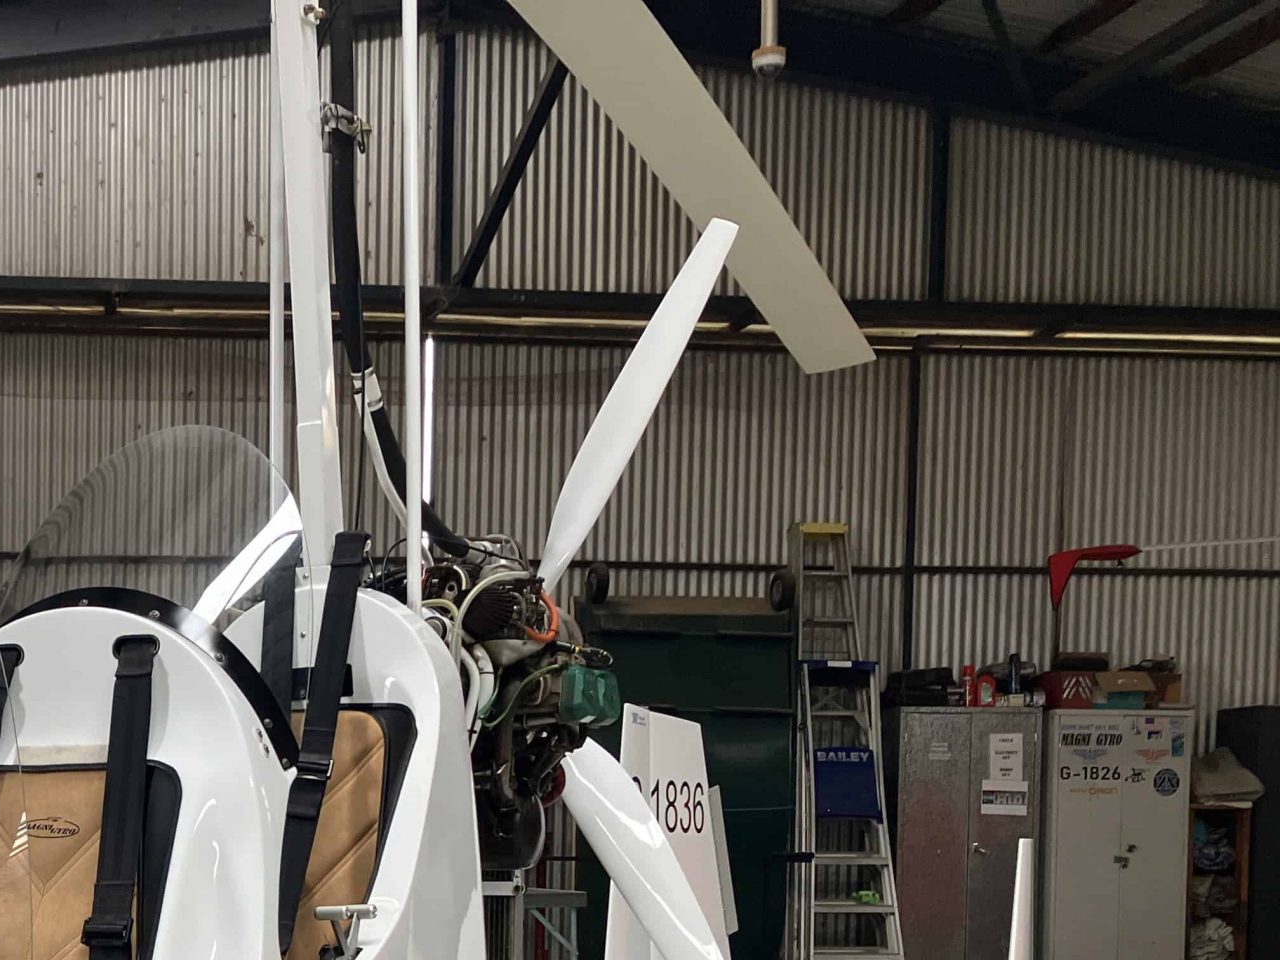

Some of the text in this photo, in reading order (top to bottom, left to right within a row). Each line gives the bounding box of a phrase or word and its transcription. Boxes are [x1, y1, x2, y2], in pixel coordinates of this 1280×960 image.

[1061, 733, 1123, 746] MAGNI GYRO
[817, 751, 869, 763] BAILEY
[1060, 766, 1122, 781] G-1826
[631, 776, 705, 834] 1836
